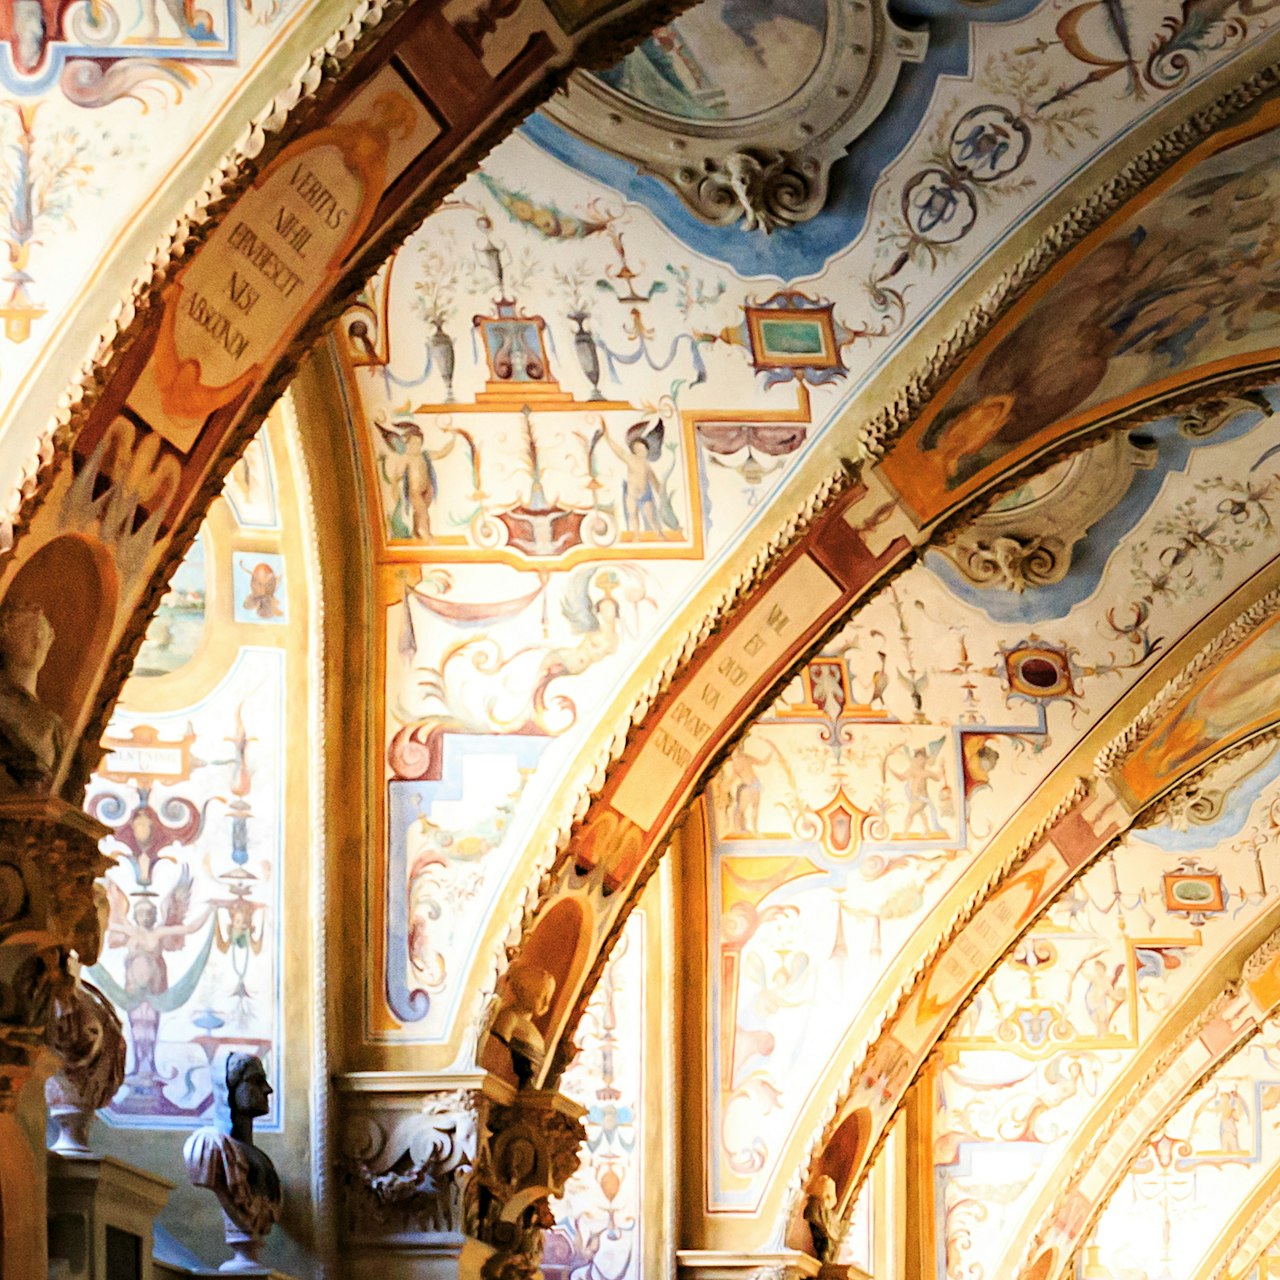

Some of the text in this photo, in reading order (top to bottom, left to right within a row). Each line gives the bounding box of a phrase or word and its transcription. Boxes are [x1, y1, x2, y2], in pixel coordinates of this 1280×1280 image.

[288, 162, 346, 229] VERITAS
[227, 221, 304, 299] ERVBESCIT
[273, 205, 312, 258] NIHIL
[186, 292, 249, 360] ABSCONDI
[229, 272, 260, 316] NISI
